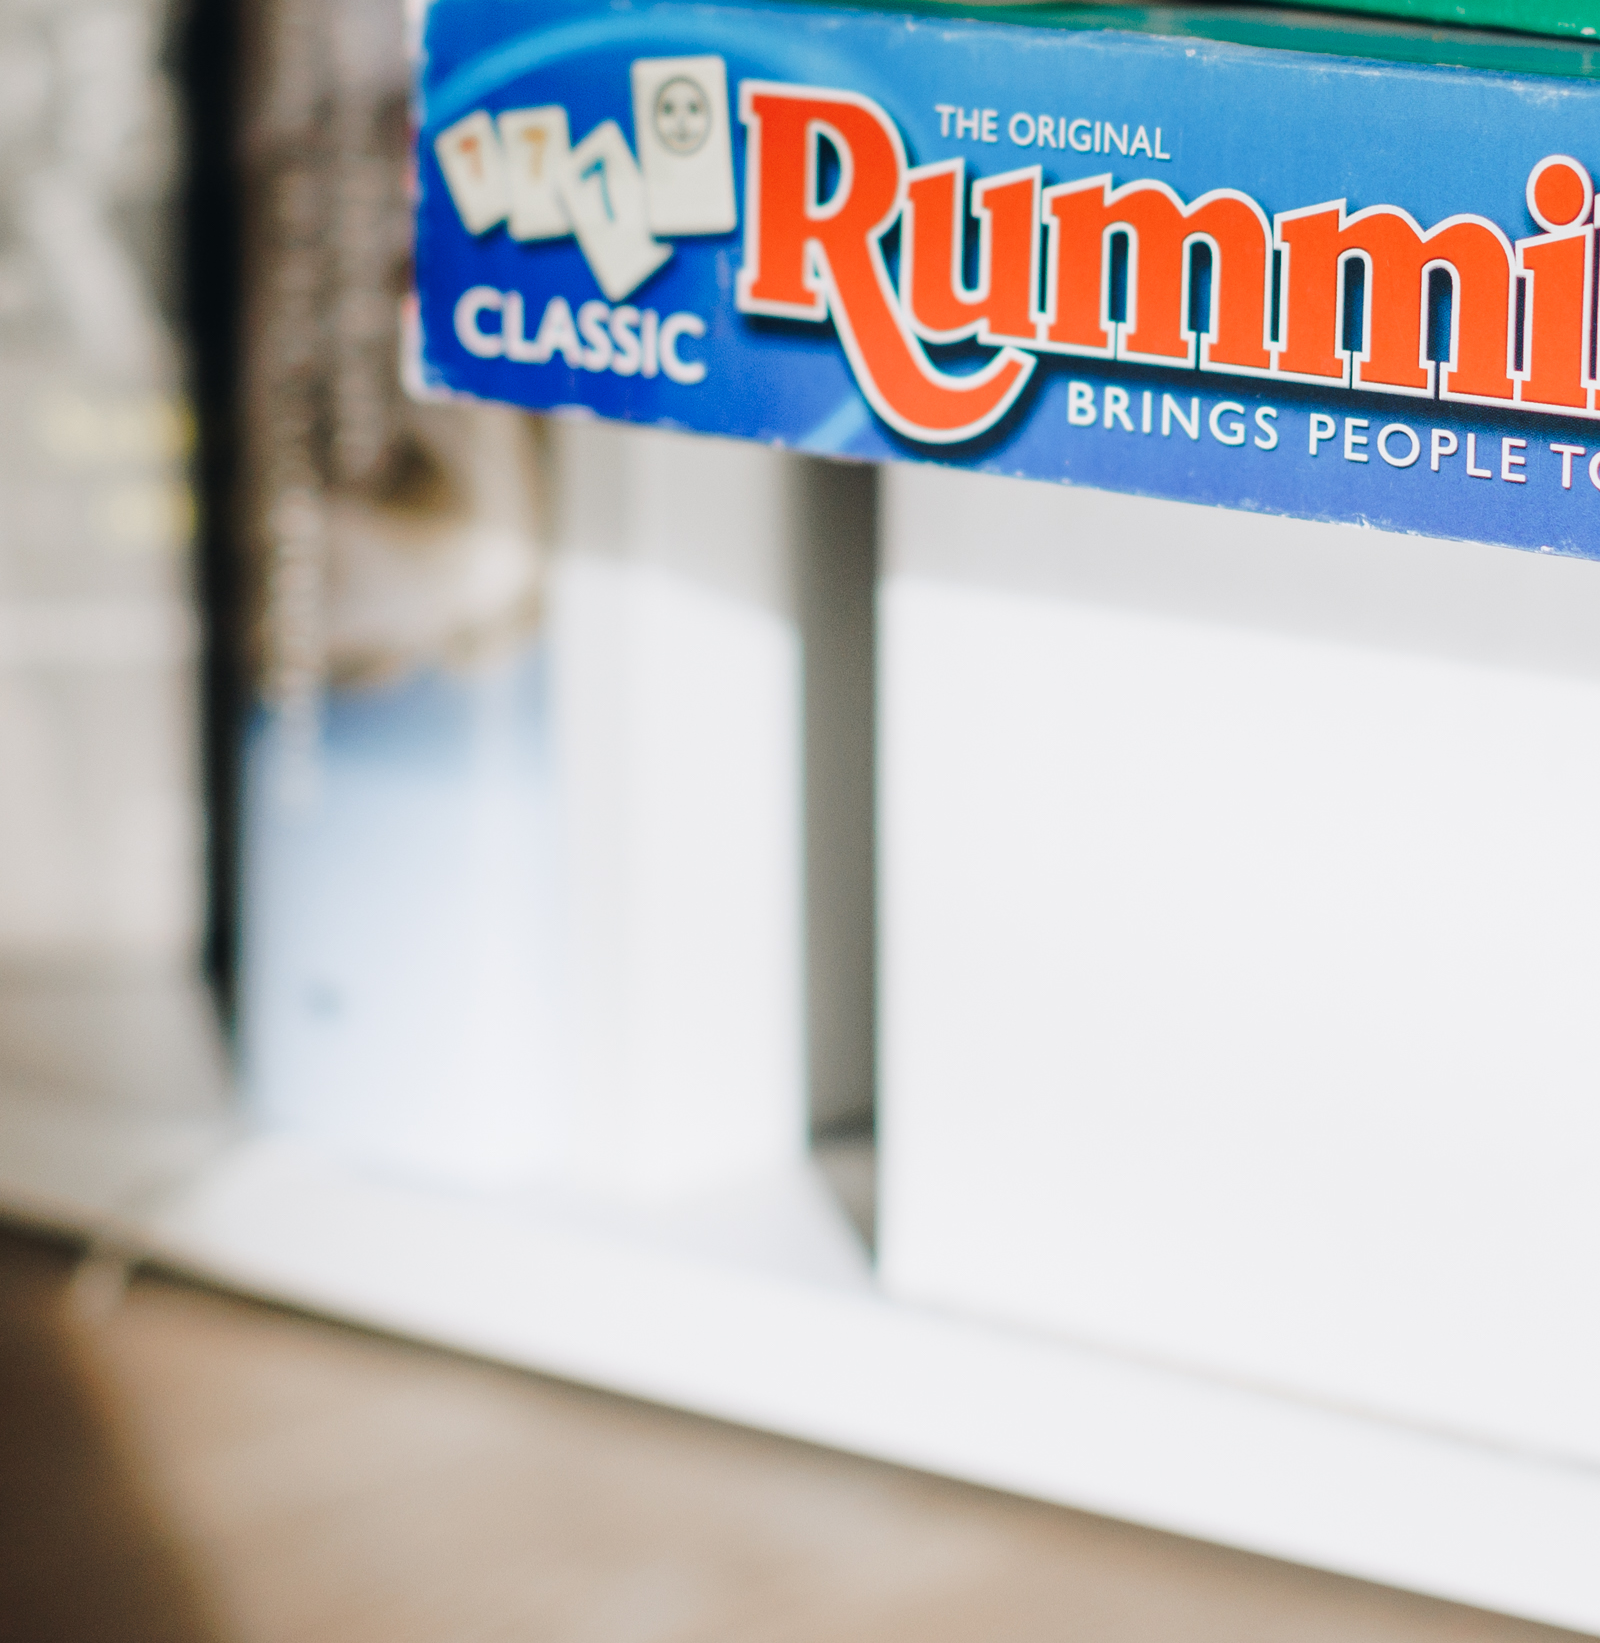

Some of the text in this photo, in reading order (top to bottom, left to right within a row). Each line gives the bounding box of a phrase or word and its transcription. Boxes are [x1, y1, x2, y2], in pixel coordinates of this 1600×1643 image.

[935, 104, 1172, 161] THE ORIGINAL
[580, 155, 616, 224] 7
[454, 285, 709, 385] CLASSIC
[1067, 382, 1280, 451] BRINGS
[1308, 412, 1529, 485] PEOPLE
